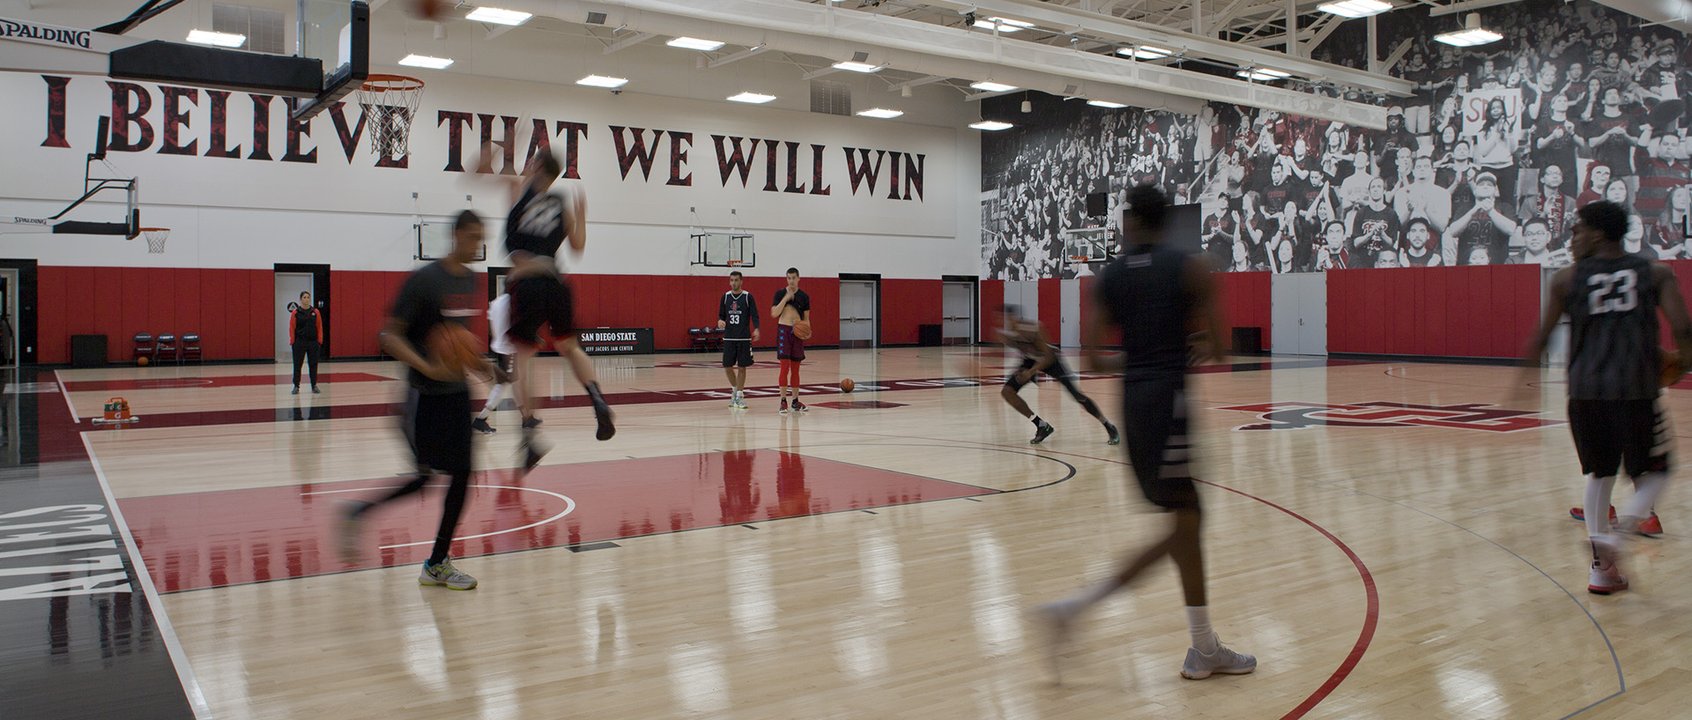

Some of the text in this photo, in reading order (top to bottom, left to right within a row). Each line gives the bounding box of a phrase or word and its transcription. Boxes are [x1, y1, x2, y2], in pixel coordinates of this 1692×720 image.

[41, 75, 926, 203] I BELIEVE THAT WE WILL WIN
[1586, 268, 1638, 315] 23
[729, 314, 740, 325] 33
[581, 332, 637, 342] SAN DIEGO STATE
